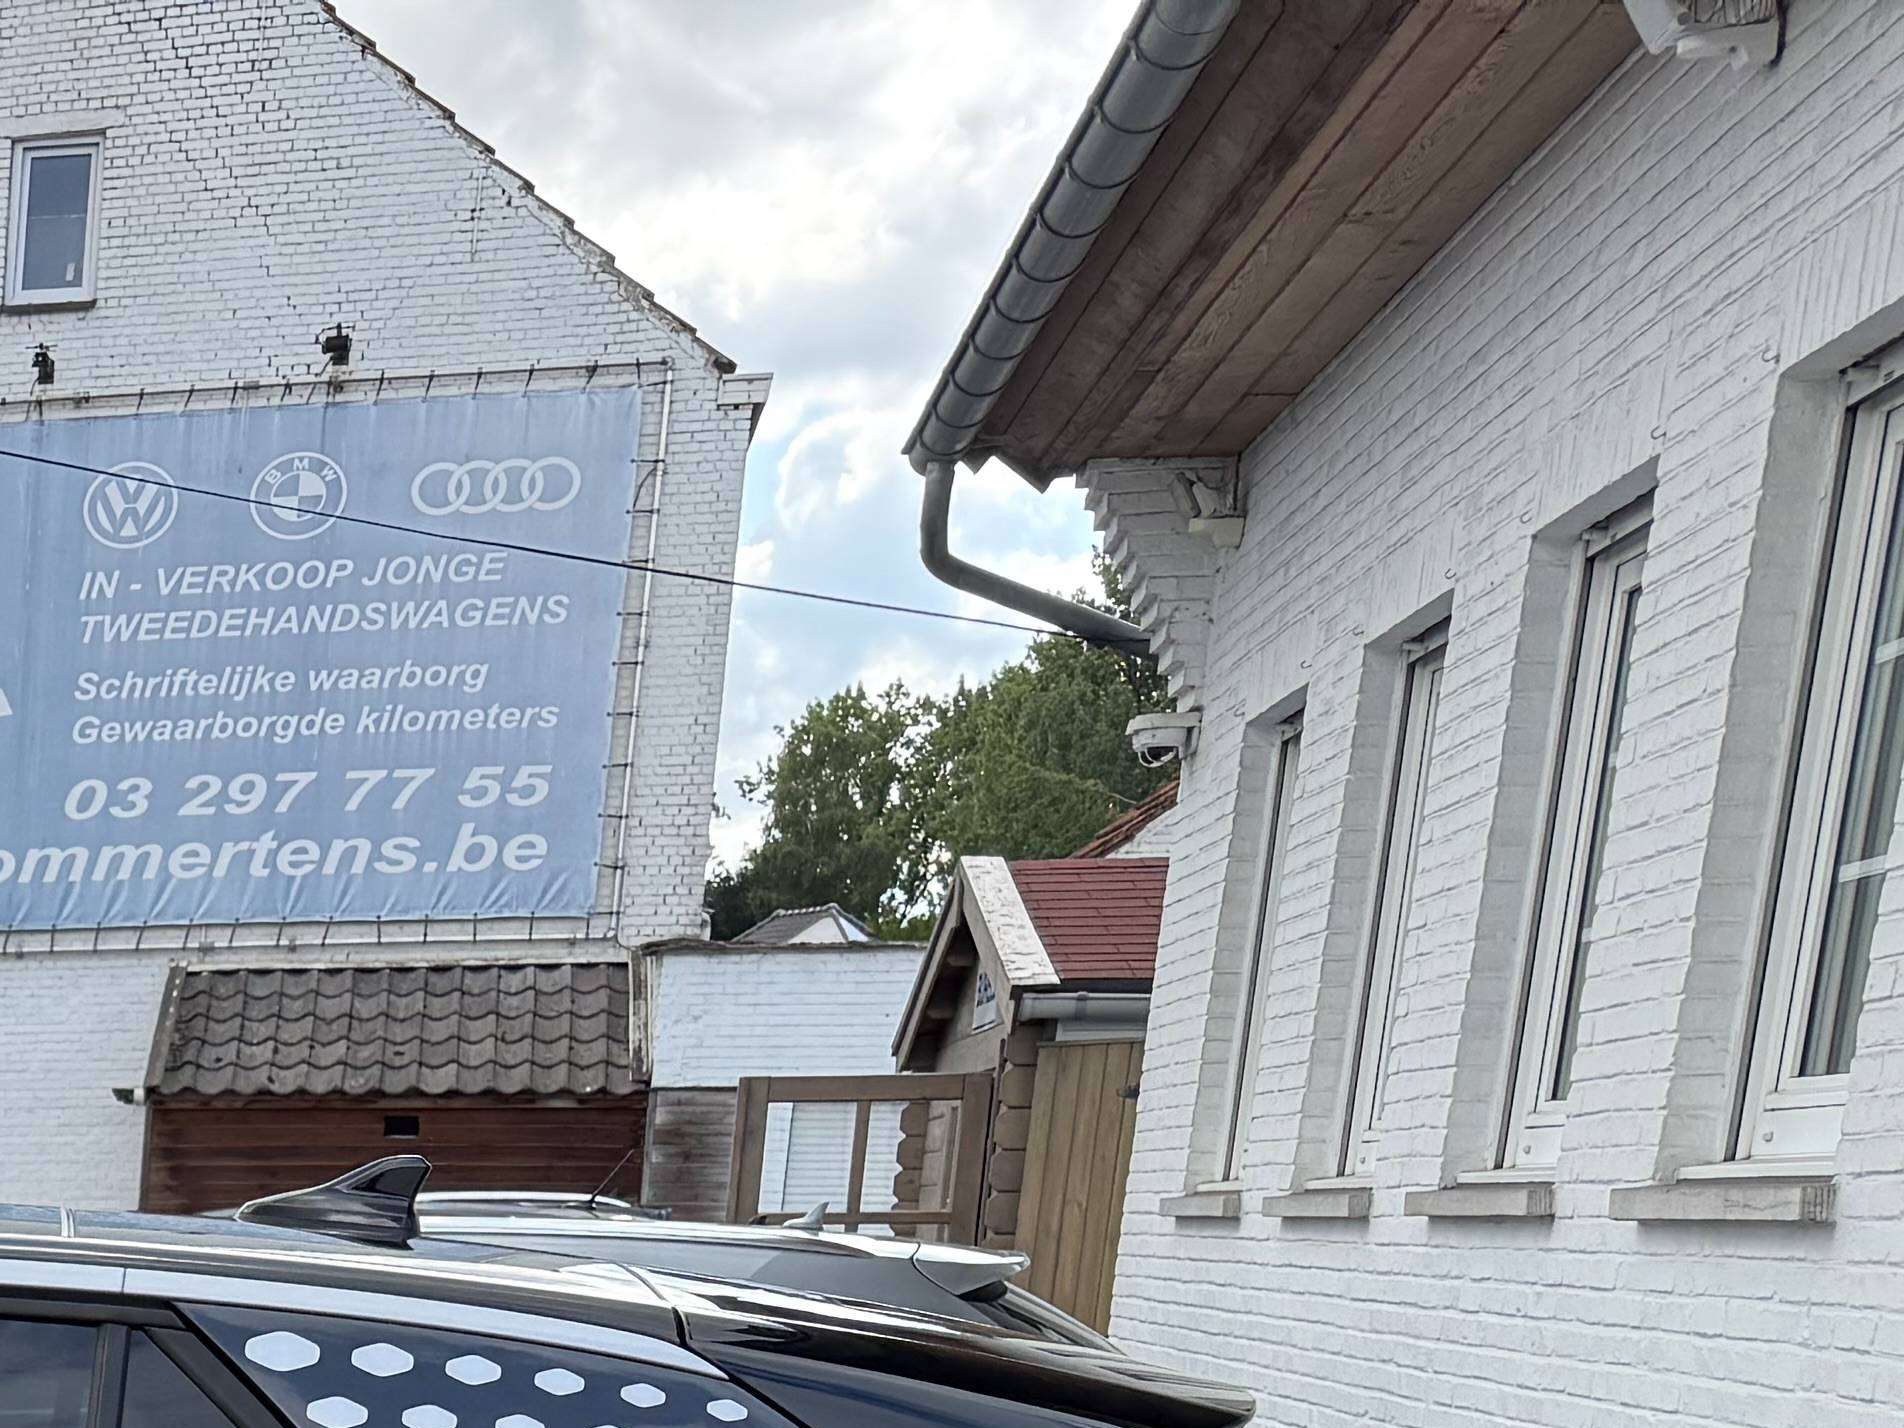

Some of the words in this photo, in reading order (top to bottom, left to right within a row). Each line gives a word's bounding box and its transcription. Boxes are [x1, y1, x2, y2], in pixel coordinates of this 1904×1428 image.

[79, 569, 120, 600] IN
[156, 559, 355, 597] VERKOOP
[361, 551, 509, 587] JONGE
[80, 594, 571, 644] TWEEDEHANDSWAGENS
[73, 664, 297, 701] Schriftelijke
[307, 659, 489, 693] waarborg
[71, 707, 345, 745] Gewaarborgde
[355, 702, 560, 736] kilometers
[63, 776, 154, 821] 03
[176, 770, 319, 816] 297
[342, 767, 436, 812] 77
[456, 764, 553, 808] 55
